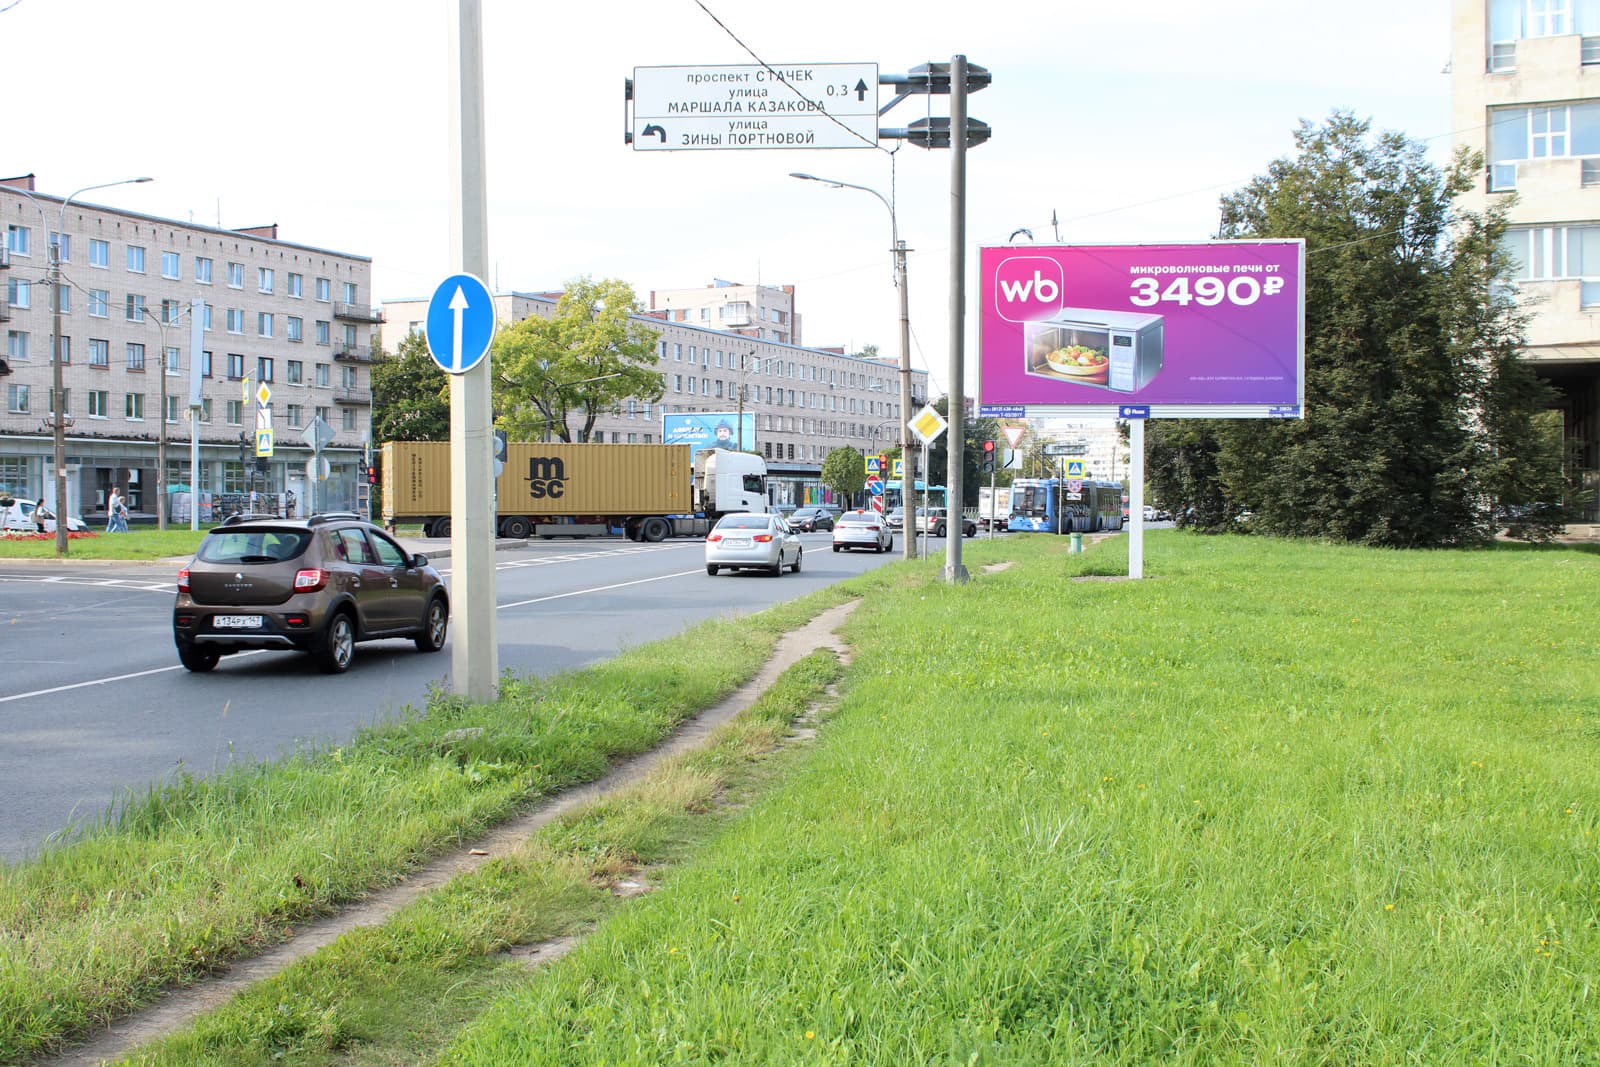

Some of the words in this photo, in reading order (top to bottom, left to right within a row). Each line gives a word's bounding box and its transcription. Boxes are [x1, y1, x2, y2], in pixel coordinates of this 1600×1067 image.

[687, 72, 750, 85] проспект
[756, 69, 814, 82] СТАЧЕК
[728, 88, 769, 100] улица
[826, 84, 849, 97] 0.3
[668, 101, 743, 113] МАРШАЛА
[748, 100, 826, 113] КАЗАКОВА
[728, 120, 768, 132] улица
[681, 133, 722, 146] ЗИНЫ
[728, 130, 815, 145] ПОРТНОВОЙ
[1130, 264, 1230, 276] микроволновые
[1233, 264, 1262, 273] печи
[1265, 264, 1280, 273] от
[1000, 270, 1059, 303] wb
